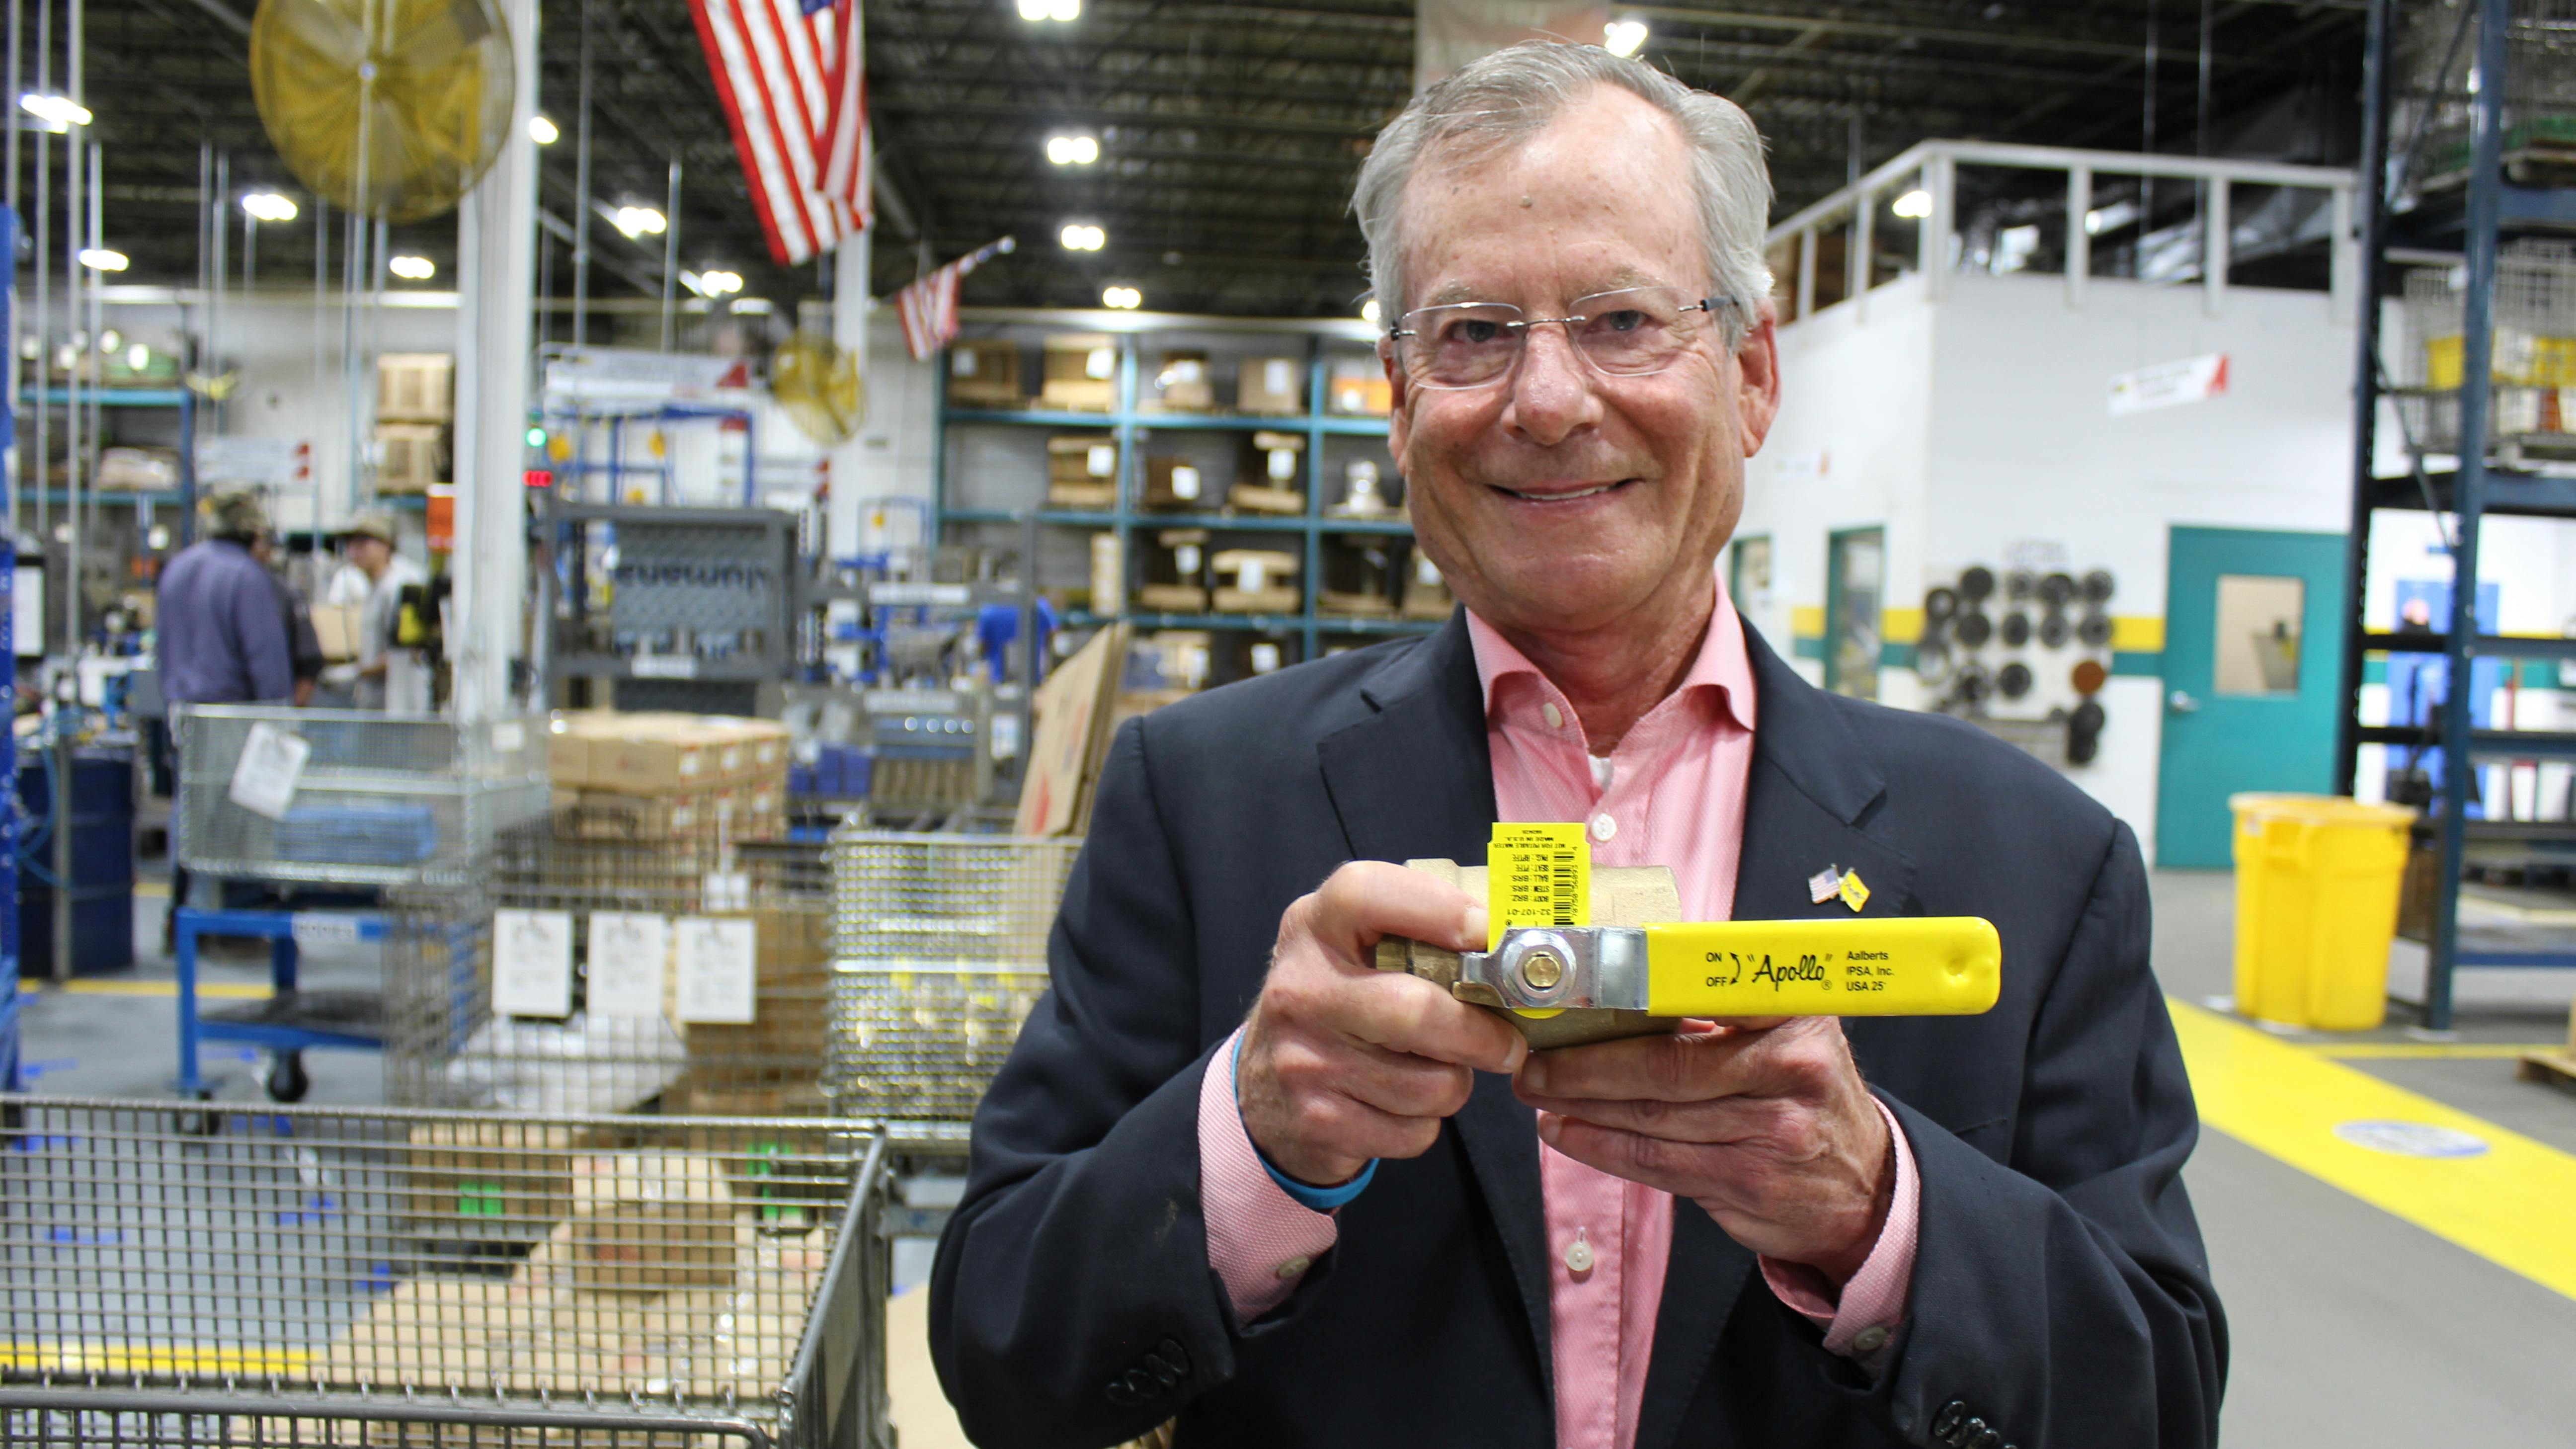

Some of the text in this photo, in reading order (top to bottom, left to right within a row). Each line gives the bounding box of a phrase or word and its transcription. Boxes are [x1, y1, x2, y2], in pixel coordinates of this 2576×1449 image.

[1706, 952, 1722, 963] ON
[1846, 950, 1889, 961] Aalberts
[1846, 966, 1895, 976] IPSA, Inc.
[1706, 976, 1727, 987] OFF
[1846, 981, 1869, 991] USA
